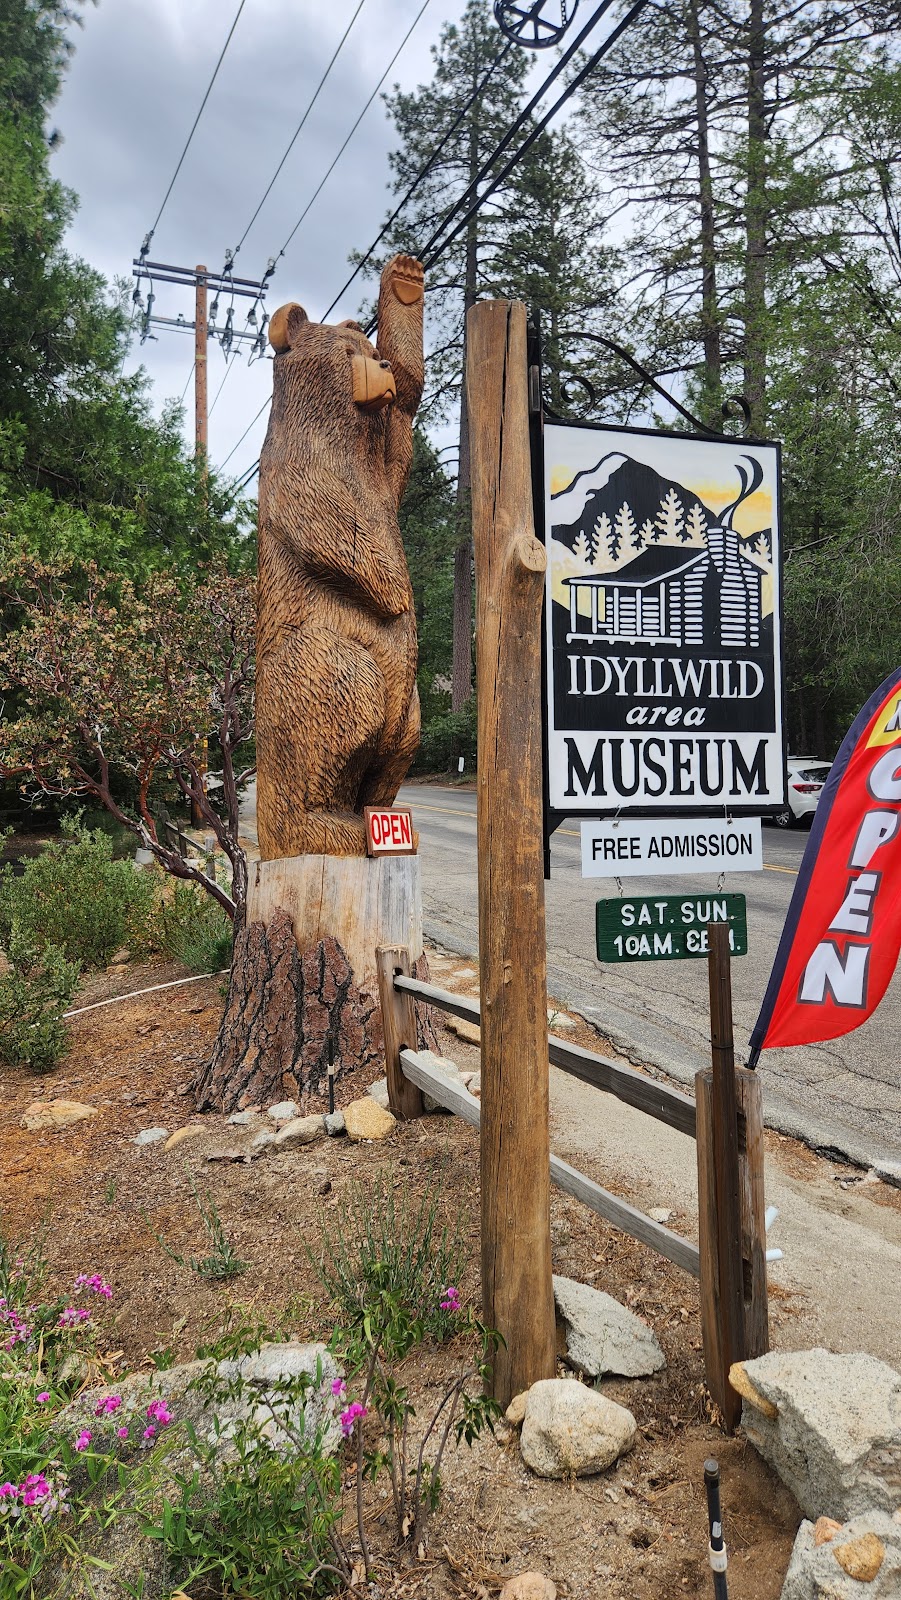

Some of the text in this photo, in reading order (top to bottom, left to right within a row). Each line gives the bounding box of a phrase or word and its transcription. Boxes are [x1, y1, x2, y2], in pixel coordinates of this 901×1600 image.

[566, 655, 765, 699] IDYLLWILD
[626, 705, 706, 727] area
[563, 737, 770, 797] MUSEUM
[371, 814, 411, 845] OPEN
[592, 833, 753, 861] FREE ADMISSION
[620, 900, 735, 926] SAT. SUN.
